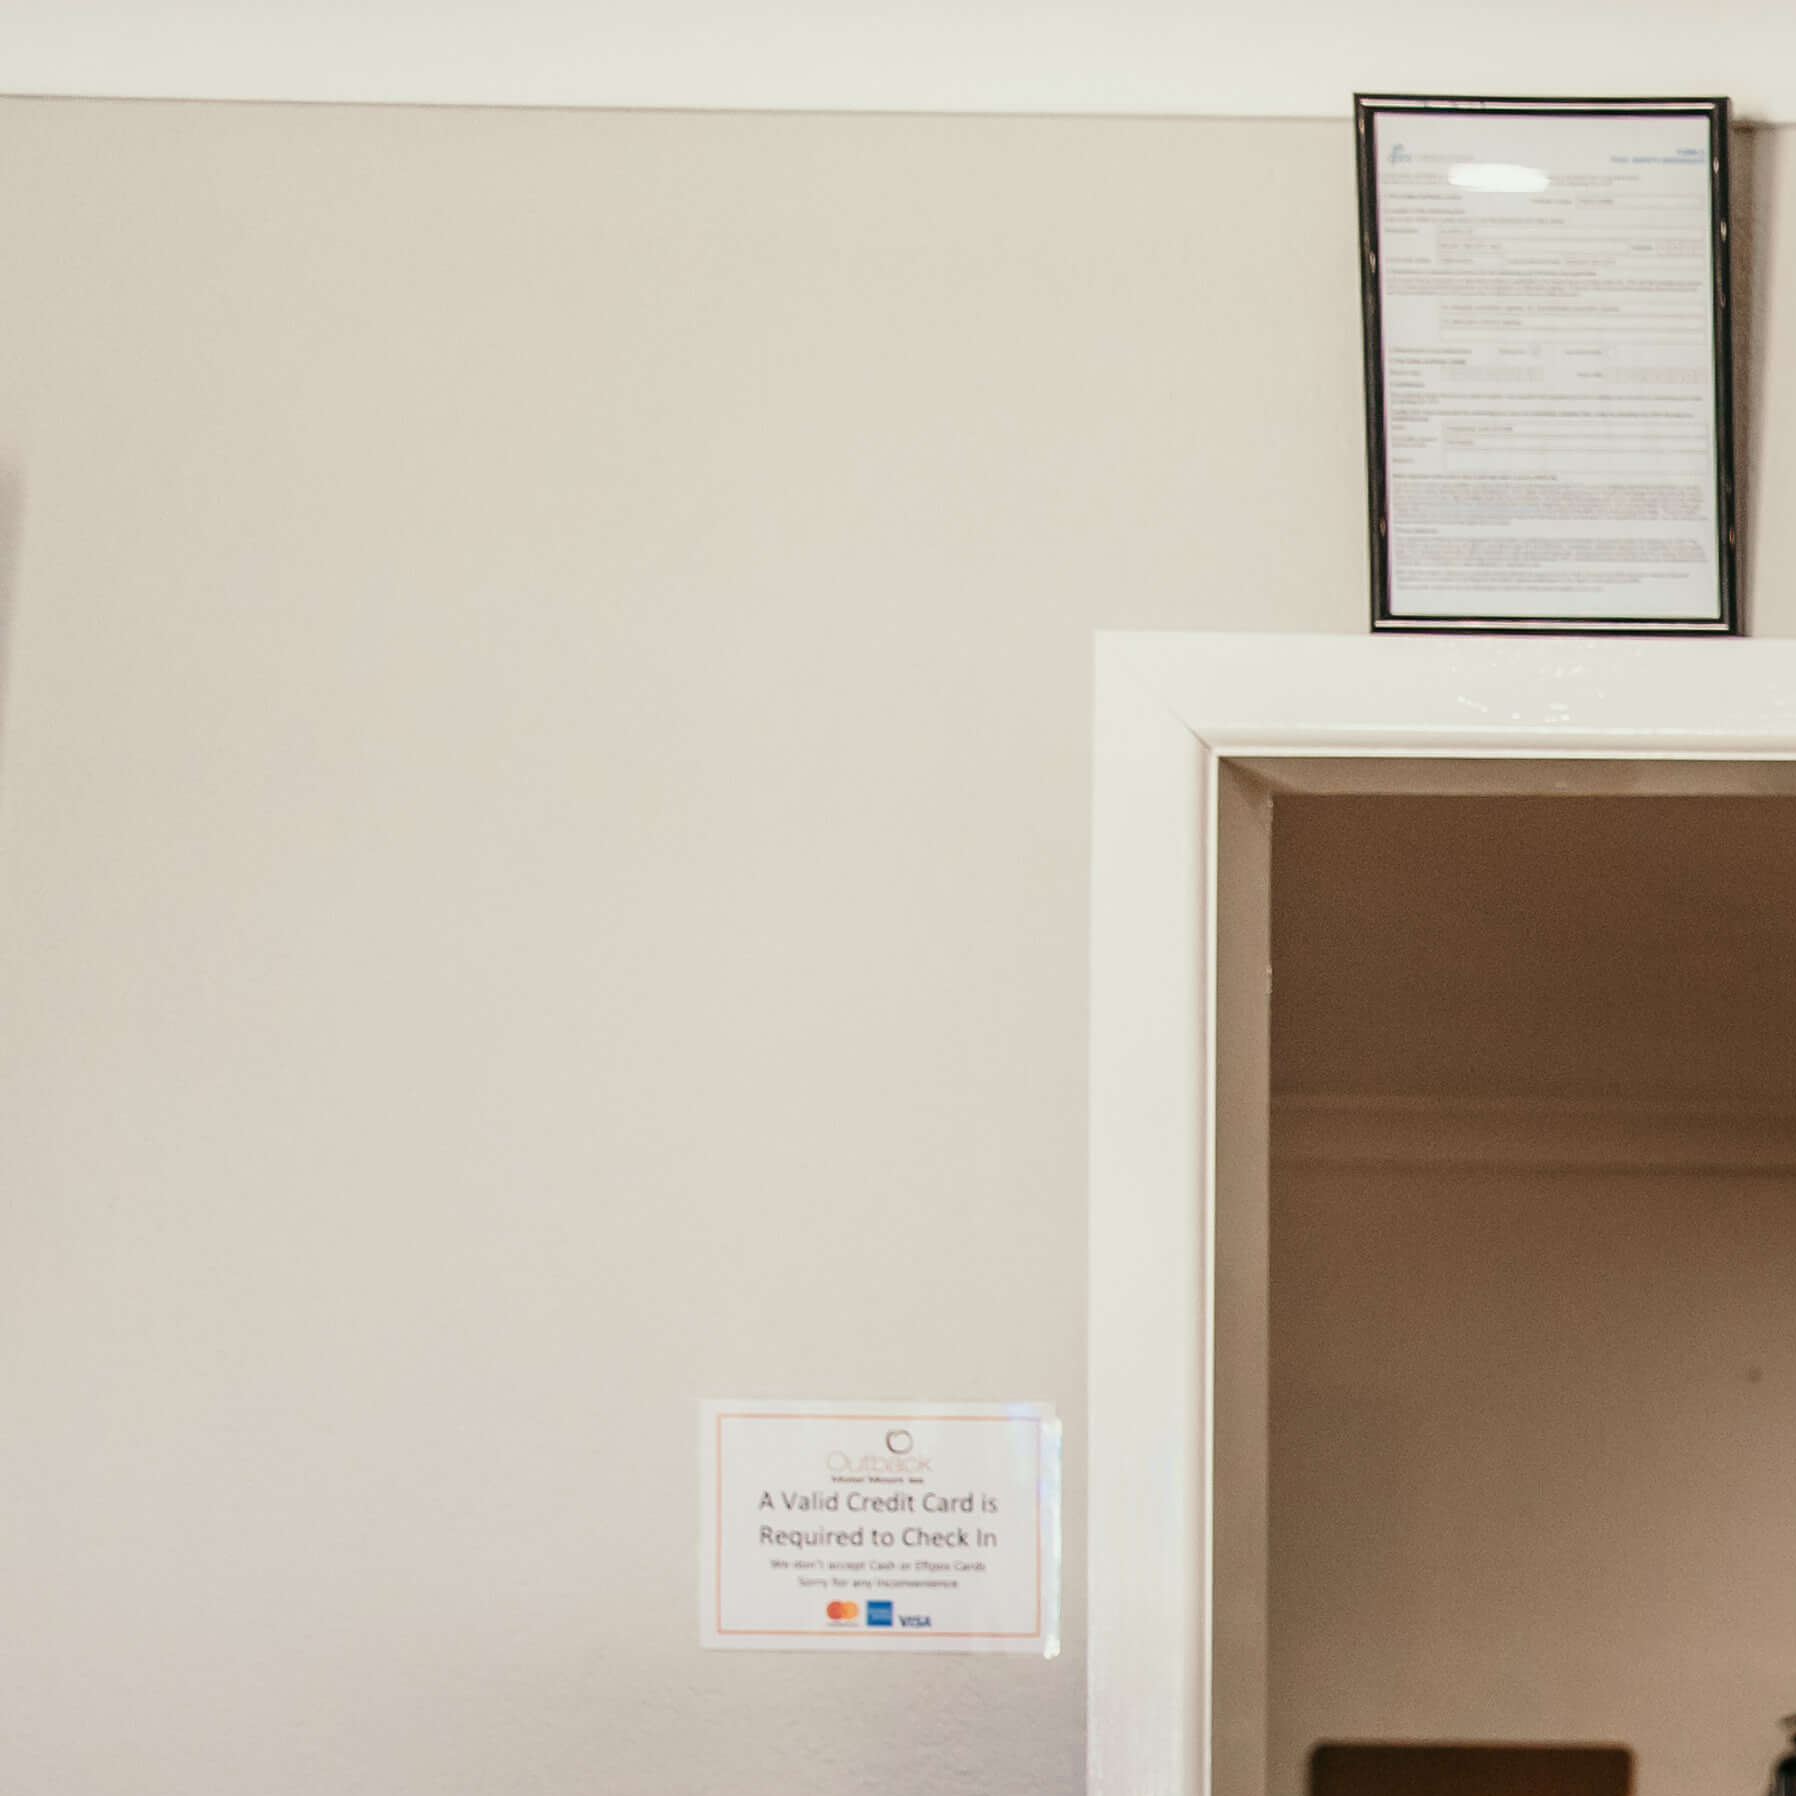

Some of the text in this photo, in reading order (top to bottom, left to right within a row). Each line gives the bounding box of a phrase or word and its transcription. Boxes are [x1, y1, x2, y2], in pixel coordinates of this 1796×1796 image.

[759, 1491, 999, 1513] A Valid Credit Card is
[759, 1525, 998, 1550] Required to Check In
[899, 1615, 932, 1627] VISA
